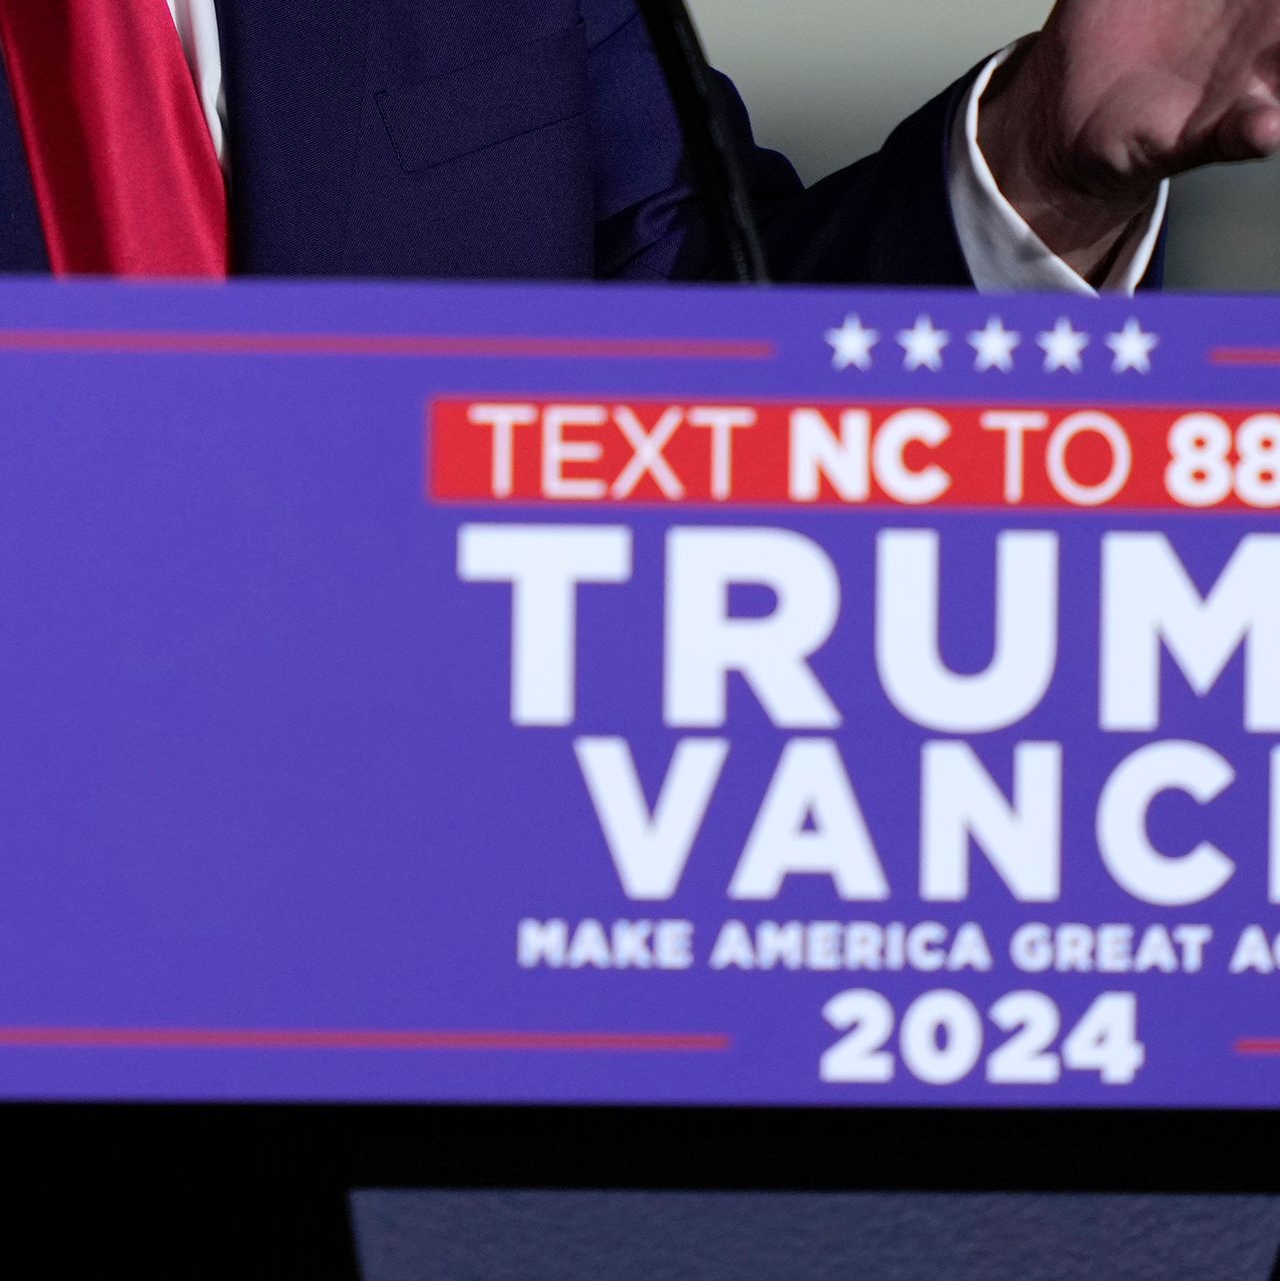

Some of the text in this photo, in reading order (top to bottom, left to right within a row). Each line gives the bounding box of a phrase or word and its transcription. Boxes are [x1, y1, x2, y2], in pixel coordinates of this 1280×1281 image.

[471, 404, 754, 499] TEXT
[789, 409, 950, 503] NC
[981, 411, 1132, 506] TO
[517, 919, 694, 970] MAKE
[709, 920, 992, 972] AMERICA
[1009, 923, 1214, 974] GREAT
[820, 988, 1146, 1085] 2024
